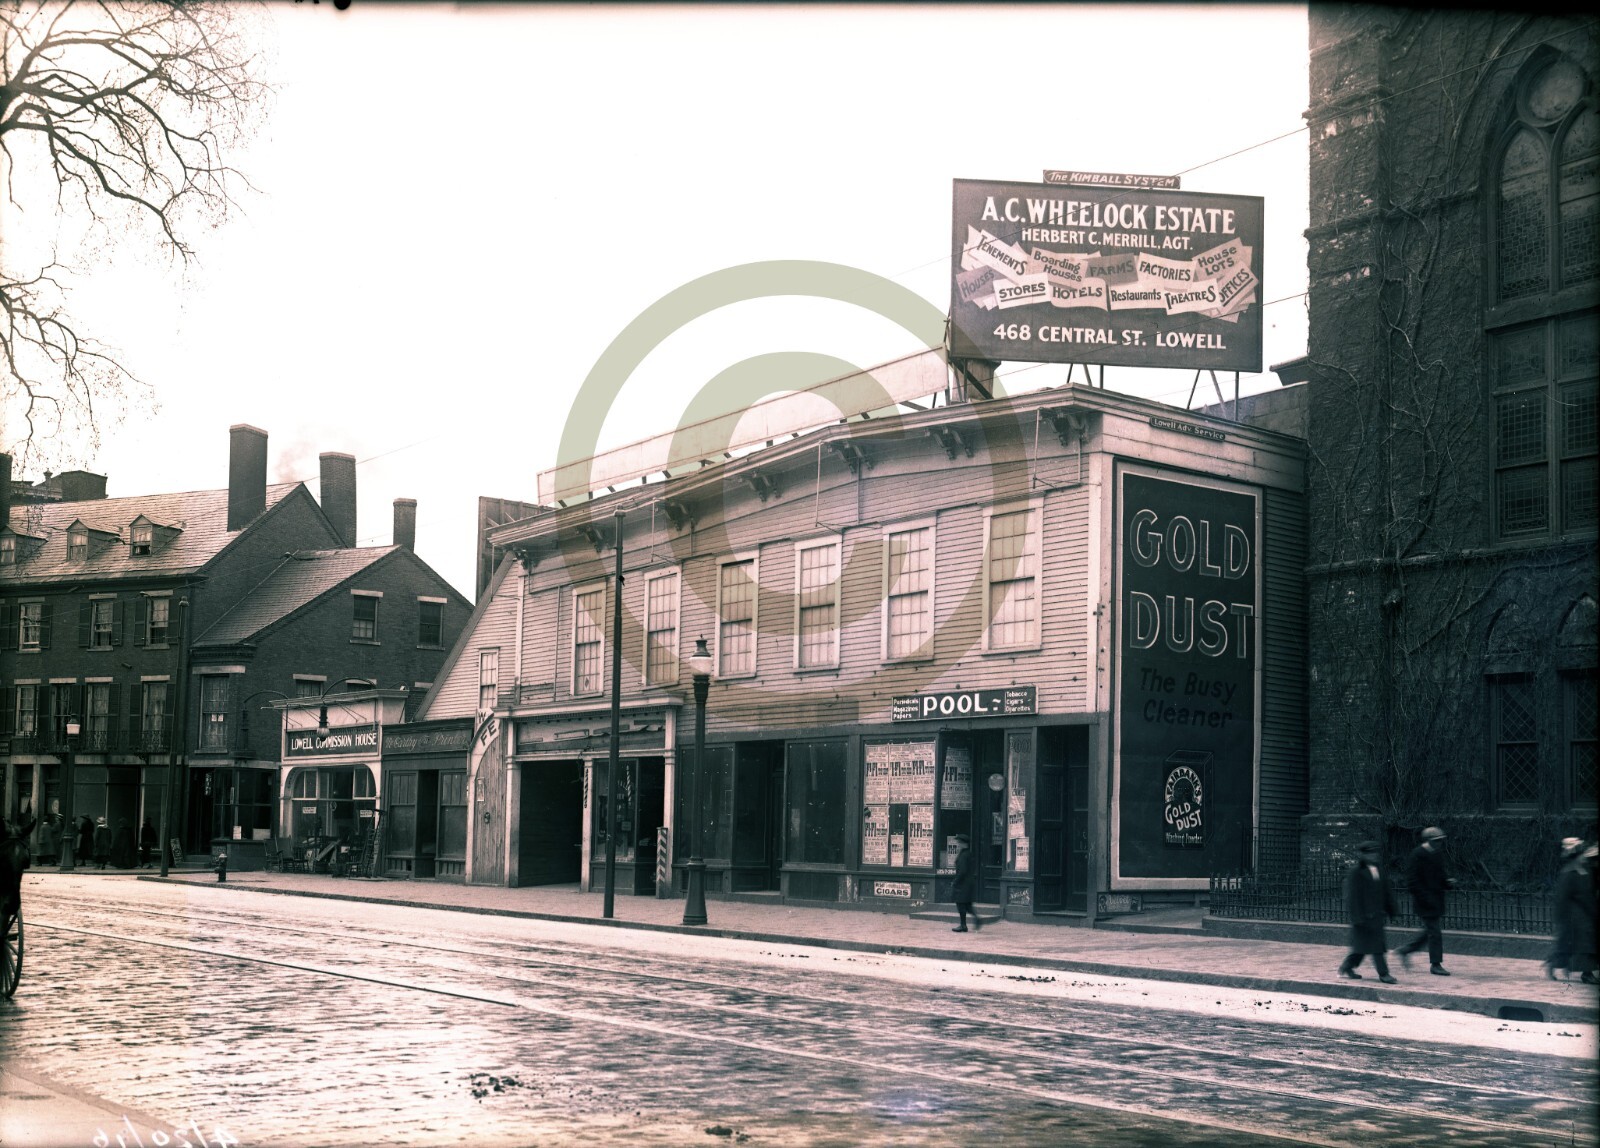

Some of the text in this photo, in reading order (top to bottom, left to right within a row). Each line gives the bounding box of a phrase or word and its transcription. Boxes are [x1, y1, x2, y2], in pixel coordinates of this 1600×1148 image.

[1049, 171, 1175, 187] The KIMBALL SYSTEM
[1026, 198, 1148, 230] WHEELOCK
[1155, 205, 1236, 235] ESTATE
[1022, 228, 1085, 245] HERBERT
[1088, 231, 1101, 246] C.
[1162, 235, 1194, 250] AGT.
[977, 234, 1028, 276] TENEMENTS
[1033, 250, 1081, 275] Boarding
[1198, 245, 1237, 268] House
[1204, 257, 1235, 276] LOTS
[1043, 264, 1083, 283] Houses
[1089, 258, 1135, 277] FARMS
[1139, 261, 1191, 282] FACTORIES
[999, 282, 1046, 299] STORES
[1052, 285, 1103, 300] HOTELS
[1110, 288, 1162, 302] Restaurants
[1164, 285, 1217, 310] THEATRES
[993, 323, 1227, 350] 468 CENTRAL ST. LOWELL
[1154, 418, 1176, 430] Lowell
[1194, 427, 1224, 440] Service
[1129, 508, 1250, 580] GOLD
[1129, 590, 1253, 659] DUST
[1006, 690, 1028, 698] Tobacco
[1141, 667, 1237, 706] The Busy
[923, 693, 988, 717] POOL
[1143, 698, 1233, 728] Cleaner
[291, 732, 377, 751] LOWELL COMMISSION HOUSE
[480, 720, 499, 747] FE
[1165, 802, 1191, 825] GOLD
[1175, 809, 1202, 832] DUST
[876, 887, 909, 896] CIGARS
